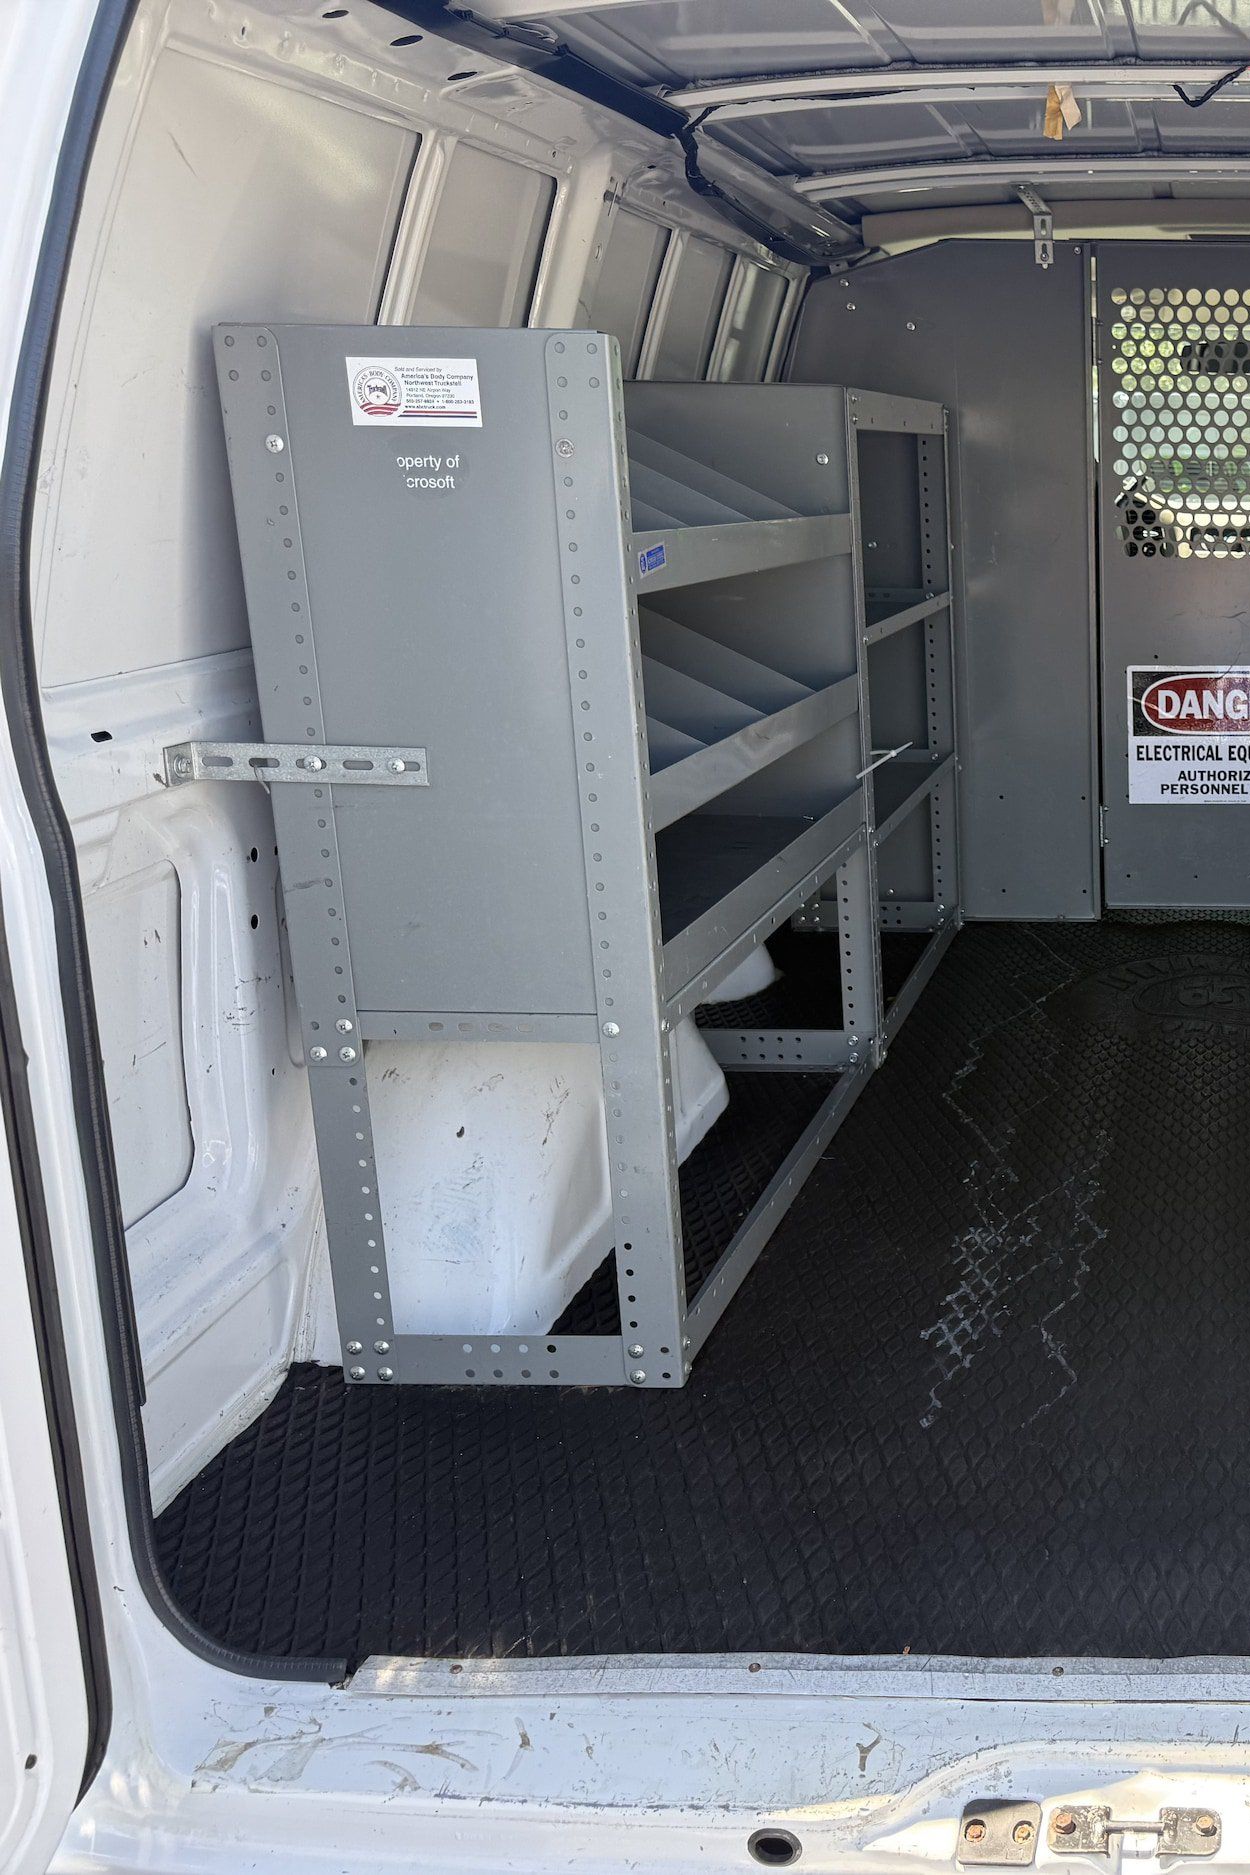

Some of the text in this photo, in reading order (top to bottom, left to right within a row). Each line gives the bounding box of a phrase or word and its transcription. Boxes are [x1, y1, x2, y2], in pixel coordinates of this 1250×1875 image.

[396, 454, 460, 471] operty of
[1136, 745, 1222, 761] ELECTRICAL
[1160, 783, 1248, 795] PERSONNEL
